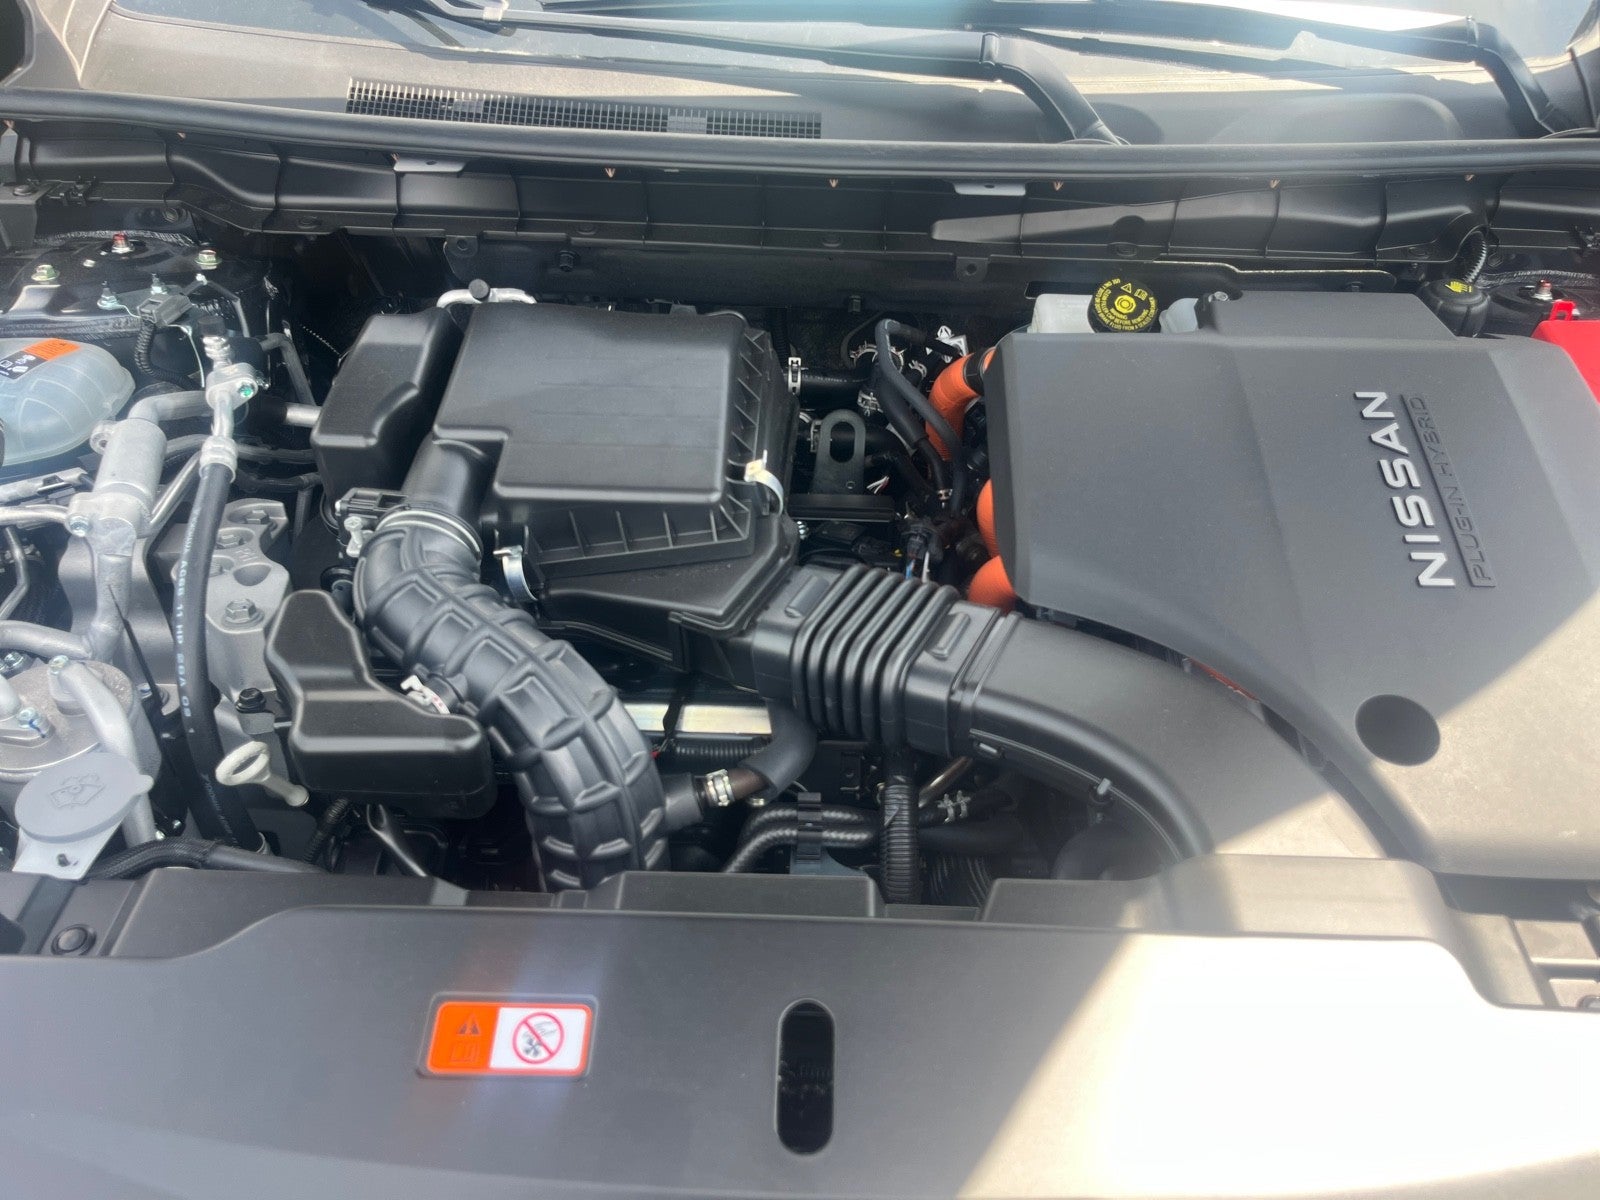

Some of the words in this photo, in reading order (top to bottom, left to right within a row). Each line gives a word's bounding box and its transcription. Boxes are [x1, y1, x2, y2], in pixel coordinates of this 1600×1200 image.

[1100, 300, 1110, 313] FILLER
[1106, 312, 1116, 320] CAP
[1113, 318, 1132, 326] BEFORE
[1131, 309, 1149, 325] REMOVING
[1109, 307, 1128, 320] WARNING
[1408, 397, 1453, 477] HYBRID
[1355, 391, 1455, 587] NISSAN
[1442, 486, 1492, 582] PLUG-IN
